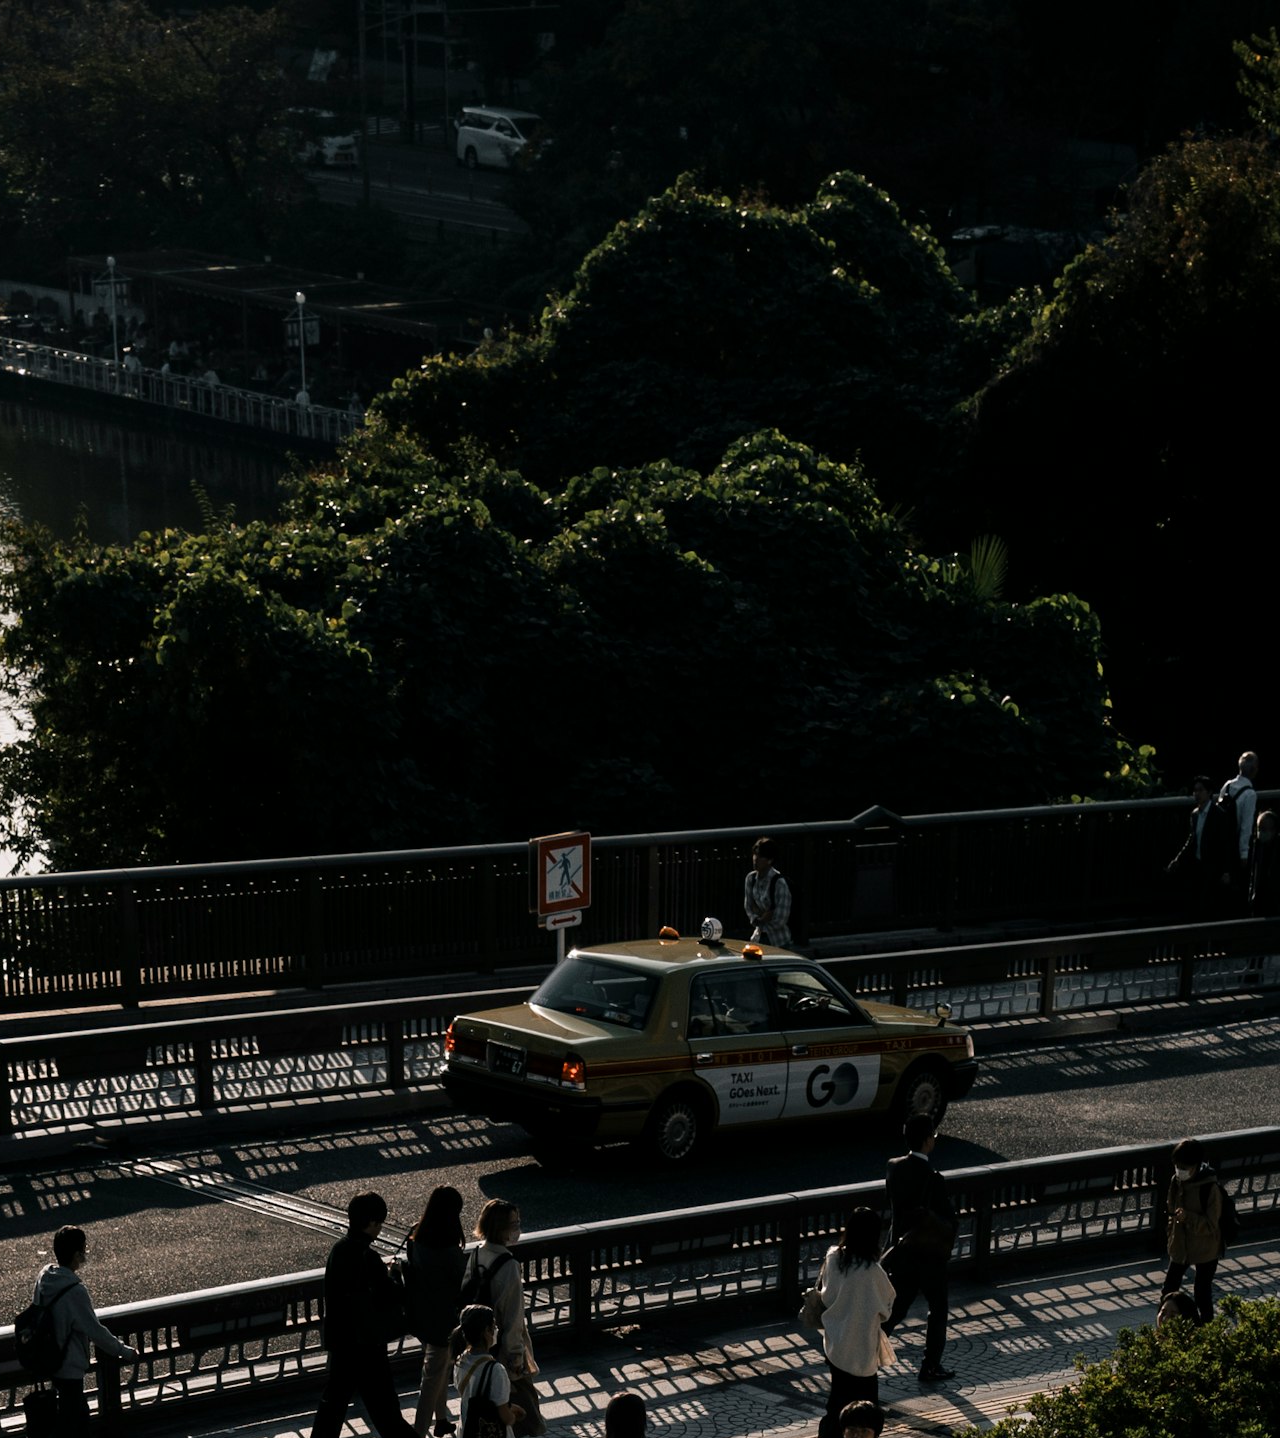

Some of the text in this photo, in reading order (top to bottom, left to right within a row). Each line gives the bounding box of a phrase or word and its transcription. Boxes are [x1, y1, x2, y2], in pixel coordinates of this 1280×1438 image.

[885, 1040, 912, 1050] TAXI
[731, 1072, 753, 1084] TAXI
[729, 1084, 781, 1099] GOes Next.
[806, 1062, 859, 1108] GO
